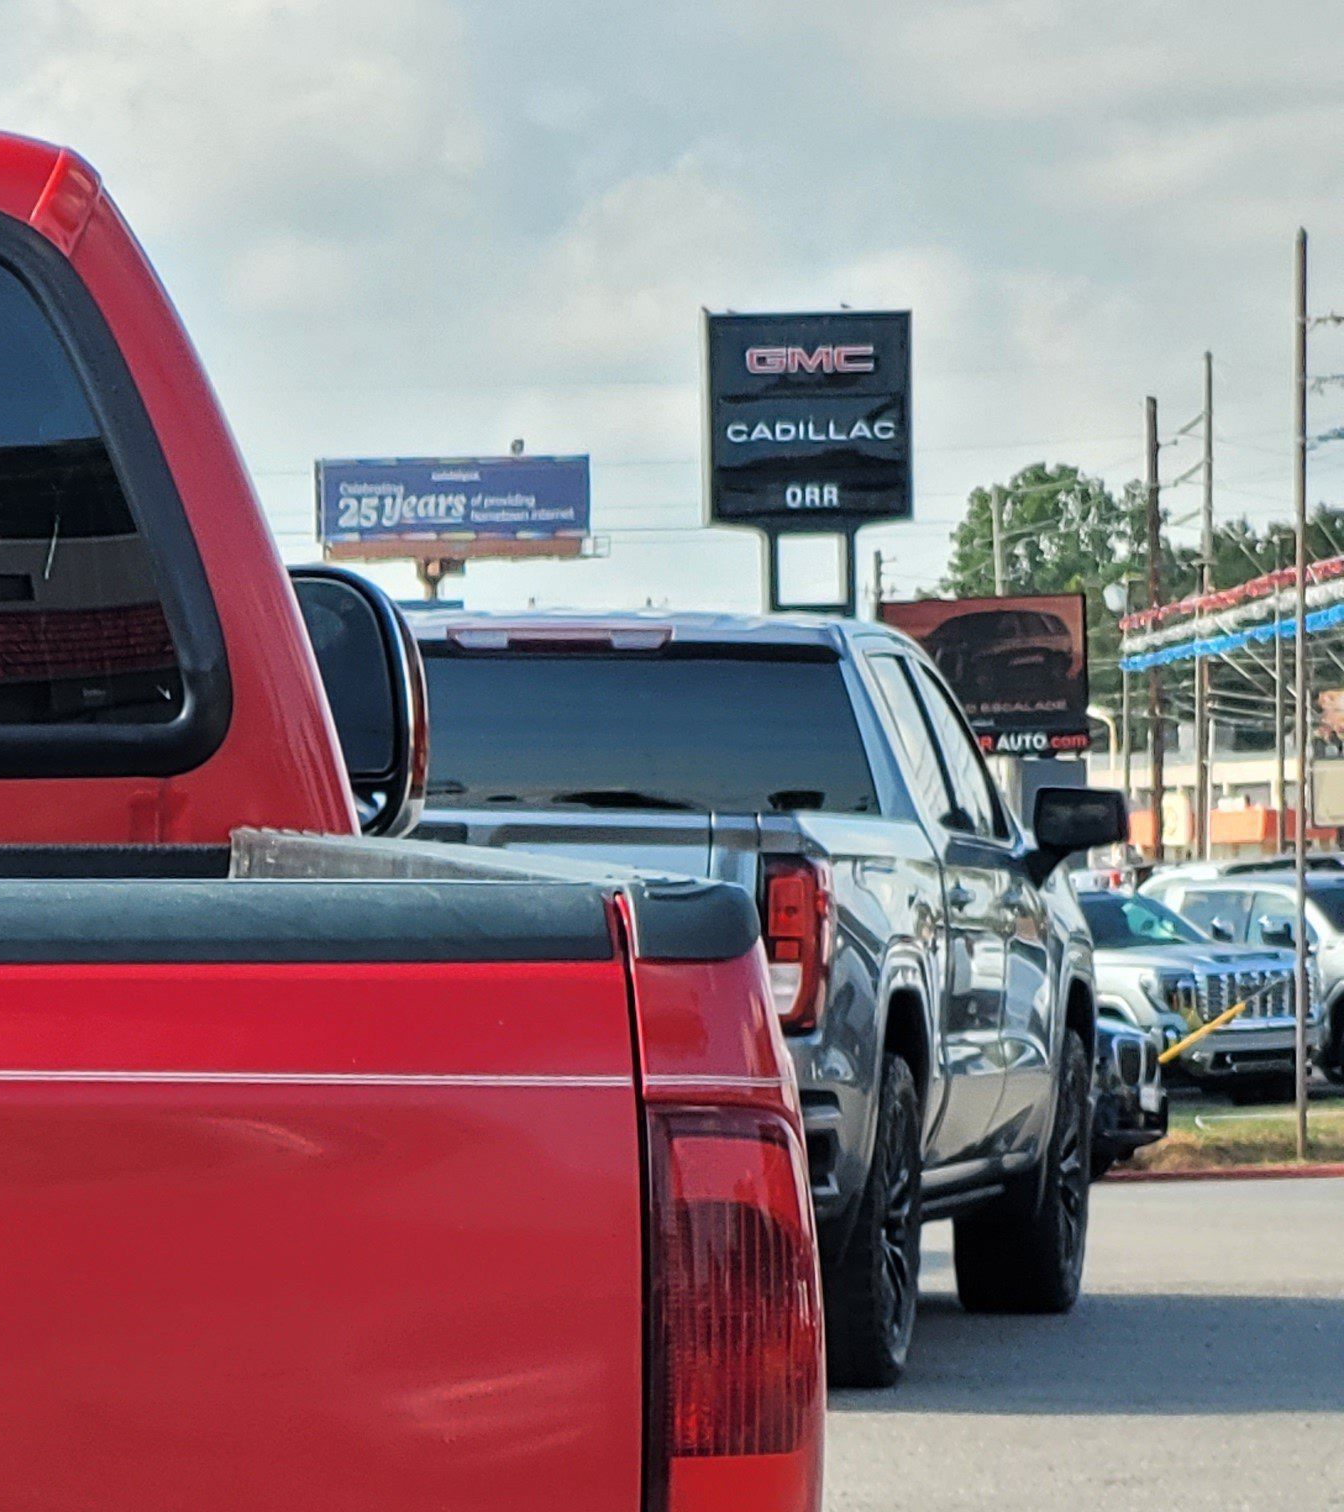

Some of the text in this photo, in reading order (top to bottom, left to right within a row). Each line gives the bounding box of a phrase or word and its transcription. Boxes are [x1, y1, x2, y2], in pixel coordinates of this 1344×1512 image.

[745, 345, 874, 374] GMC
[726, 419, 895, 443] CADILLAC
[785, 483, 839, 508] ORR
[338, 497, 379, 528] 25
